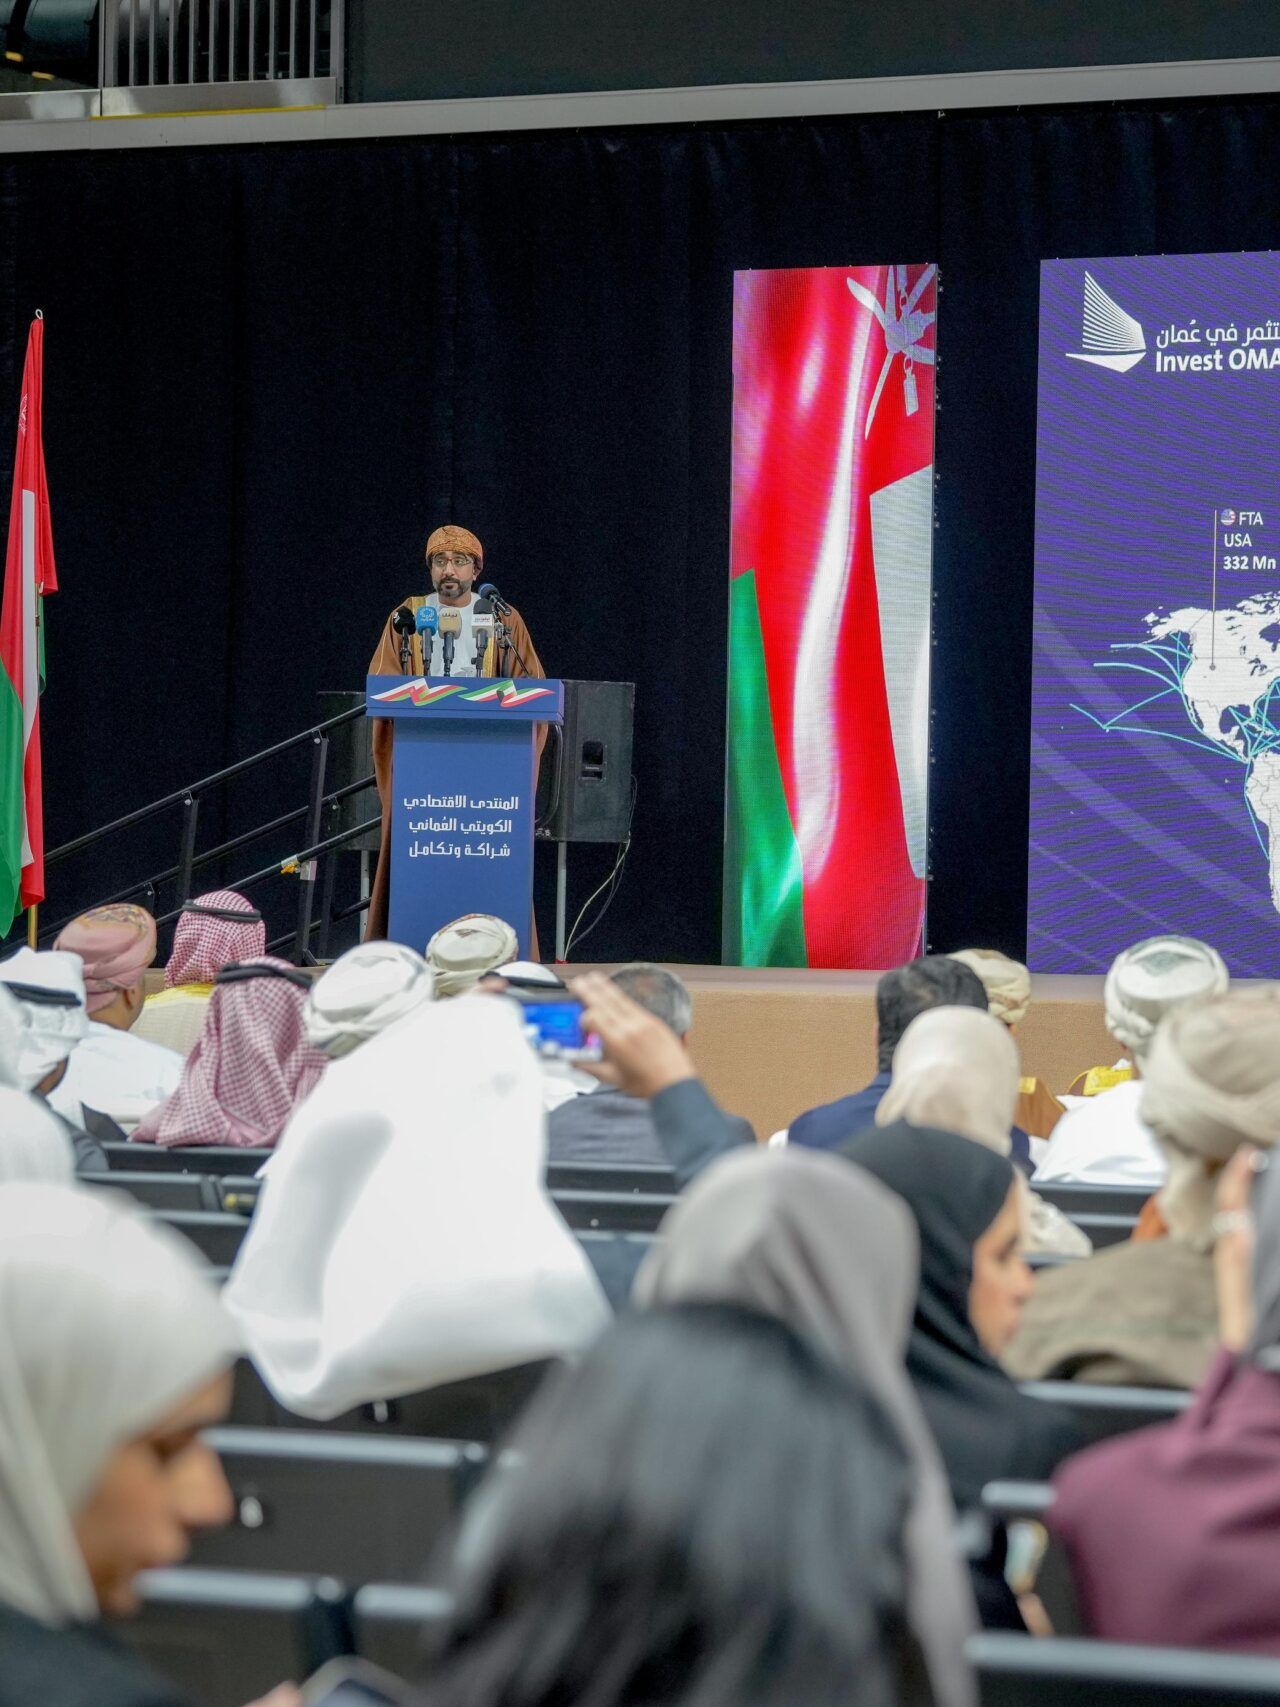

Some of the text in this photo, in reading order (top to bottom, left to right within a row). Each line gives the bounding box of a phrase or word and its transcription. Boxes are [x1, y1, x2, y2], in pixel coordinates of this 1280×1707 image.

[1205, 322, 1238, 347] في
[1155, 348, 1224, 373] Invest
[1239, 511, 1264, 526] FTA
[1224, 532, 1253, 548] USA
[1223, 555, 1277, 570] 332 Mn
[403, 794, 519, 811] المنتدى الاقتصادي
[460, 819, 512, 835] الكويتي
